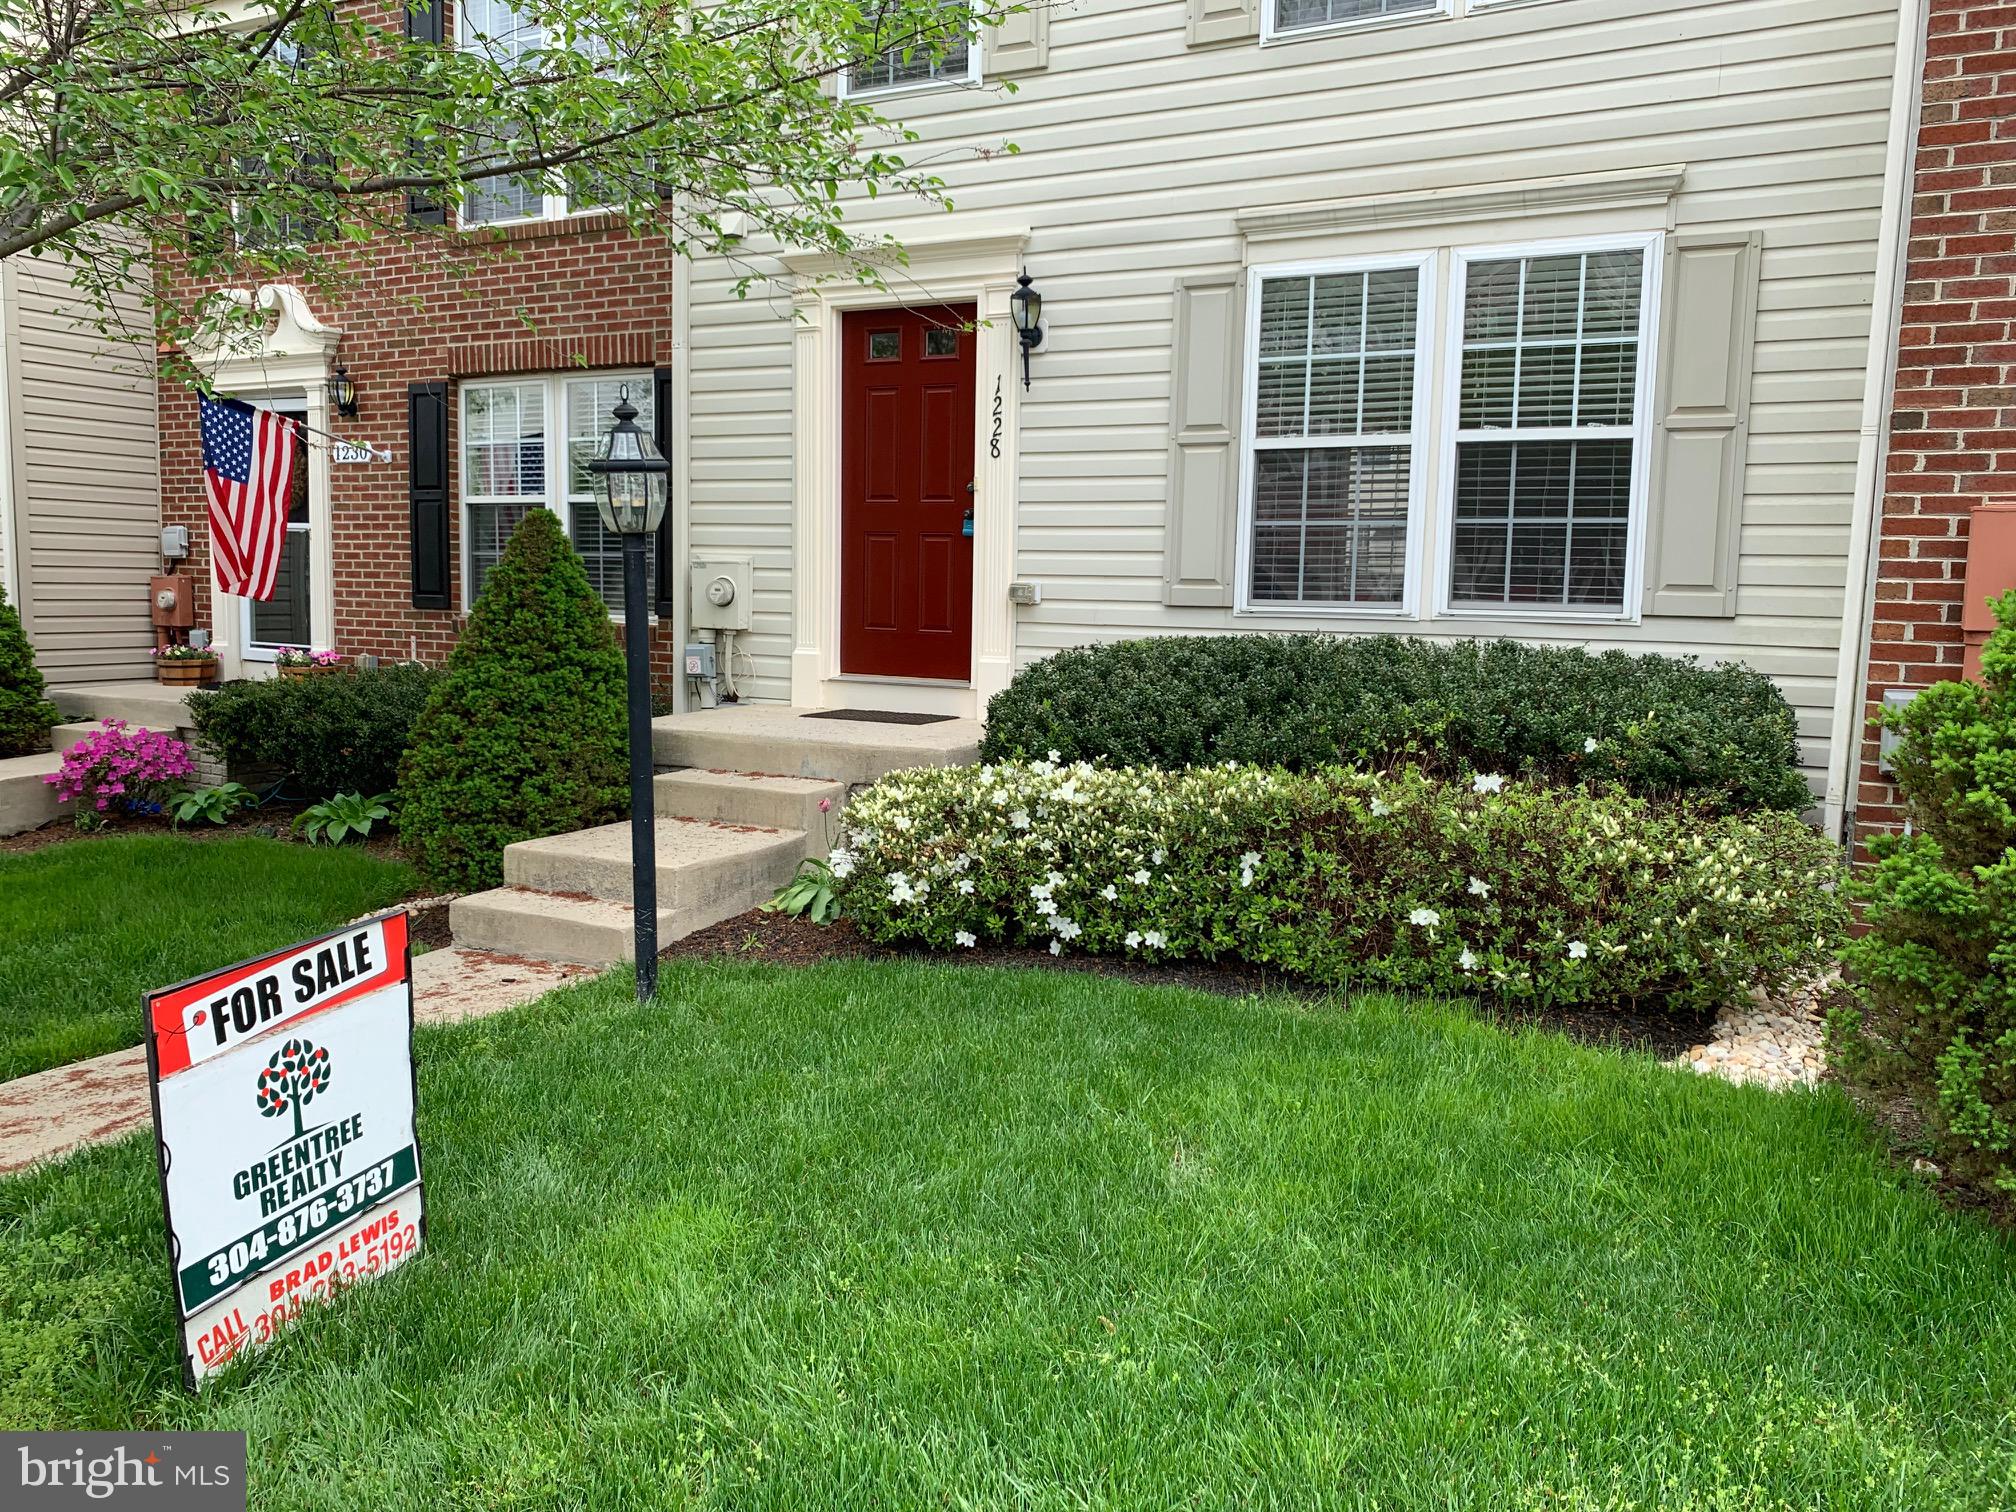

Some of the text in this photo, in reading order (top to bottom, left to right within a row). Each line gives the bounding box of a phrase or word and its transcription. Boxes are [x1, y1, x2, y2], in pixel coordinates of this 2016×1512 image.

[335, 445, 368, 461] 1230
[990, 374, 1002, 459] 1228
[210, 931, 373, 1047] FOR SALE
[233, 1112, 364, 1201] GREENTREE
[259, 1150, 344, 1219] REALTY
[207, 1158, 396, 1286] 304-876-3737
[269, 1209, 400, 1303] BRAD LEWIS
[197, 1307, 250, 1365] CALL
